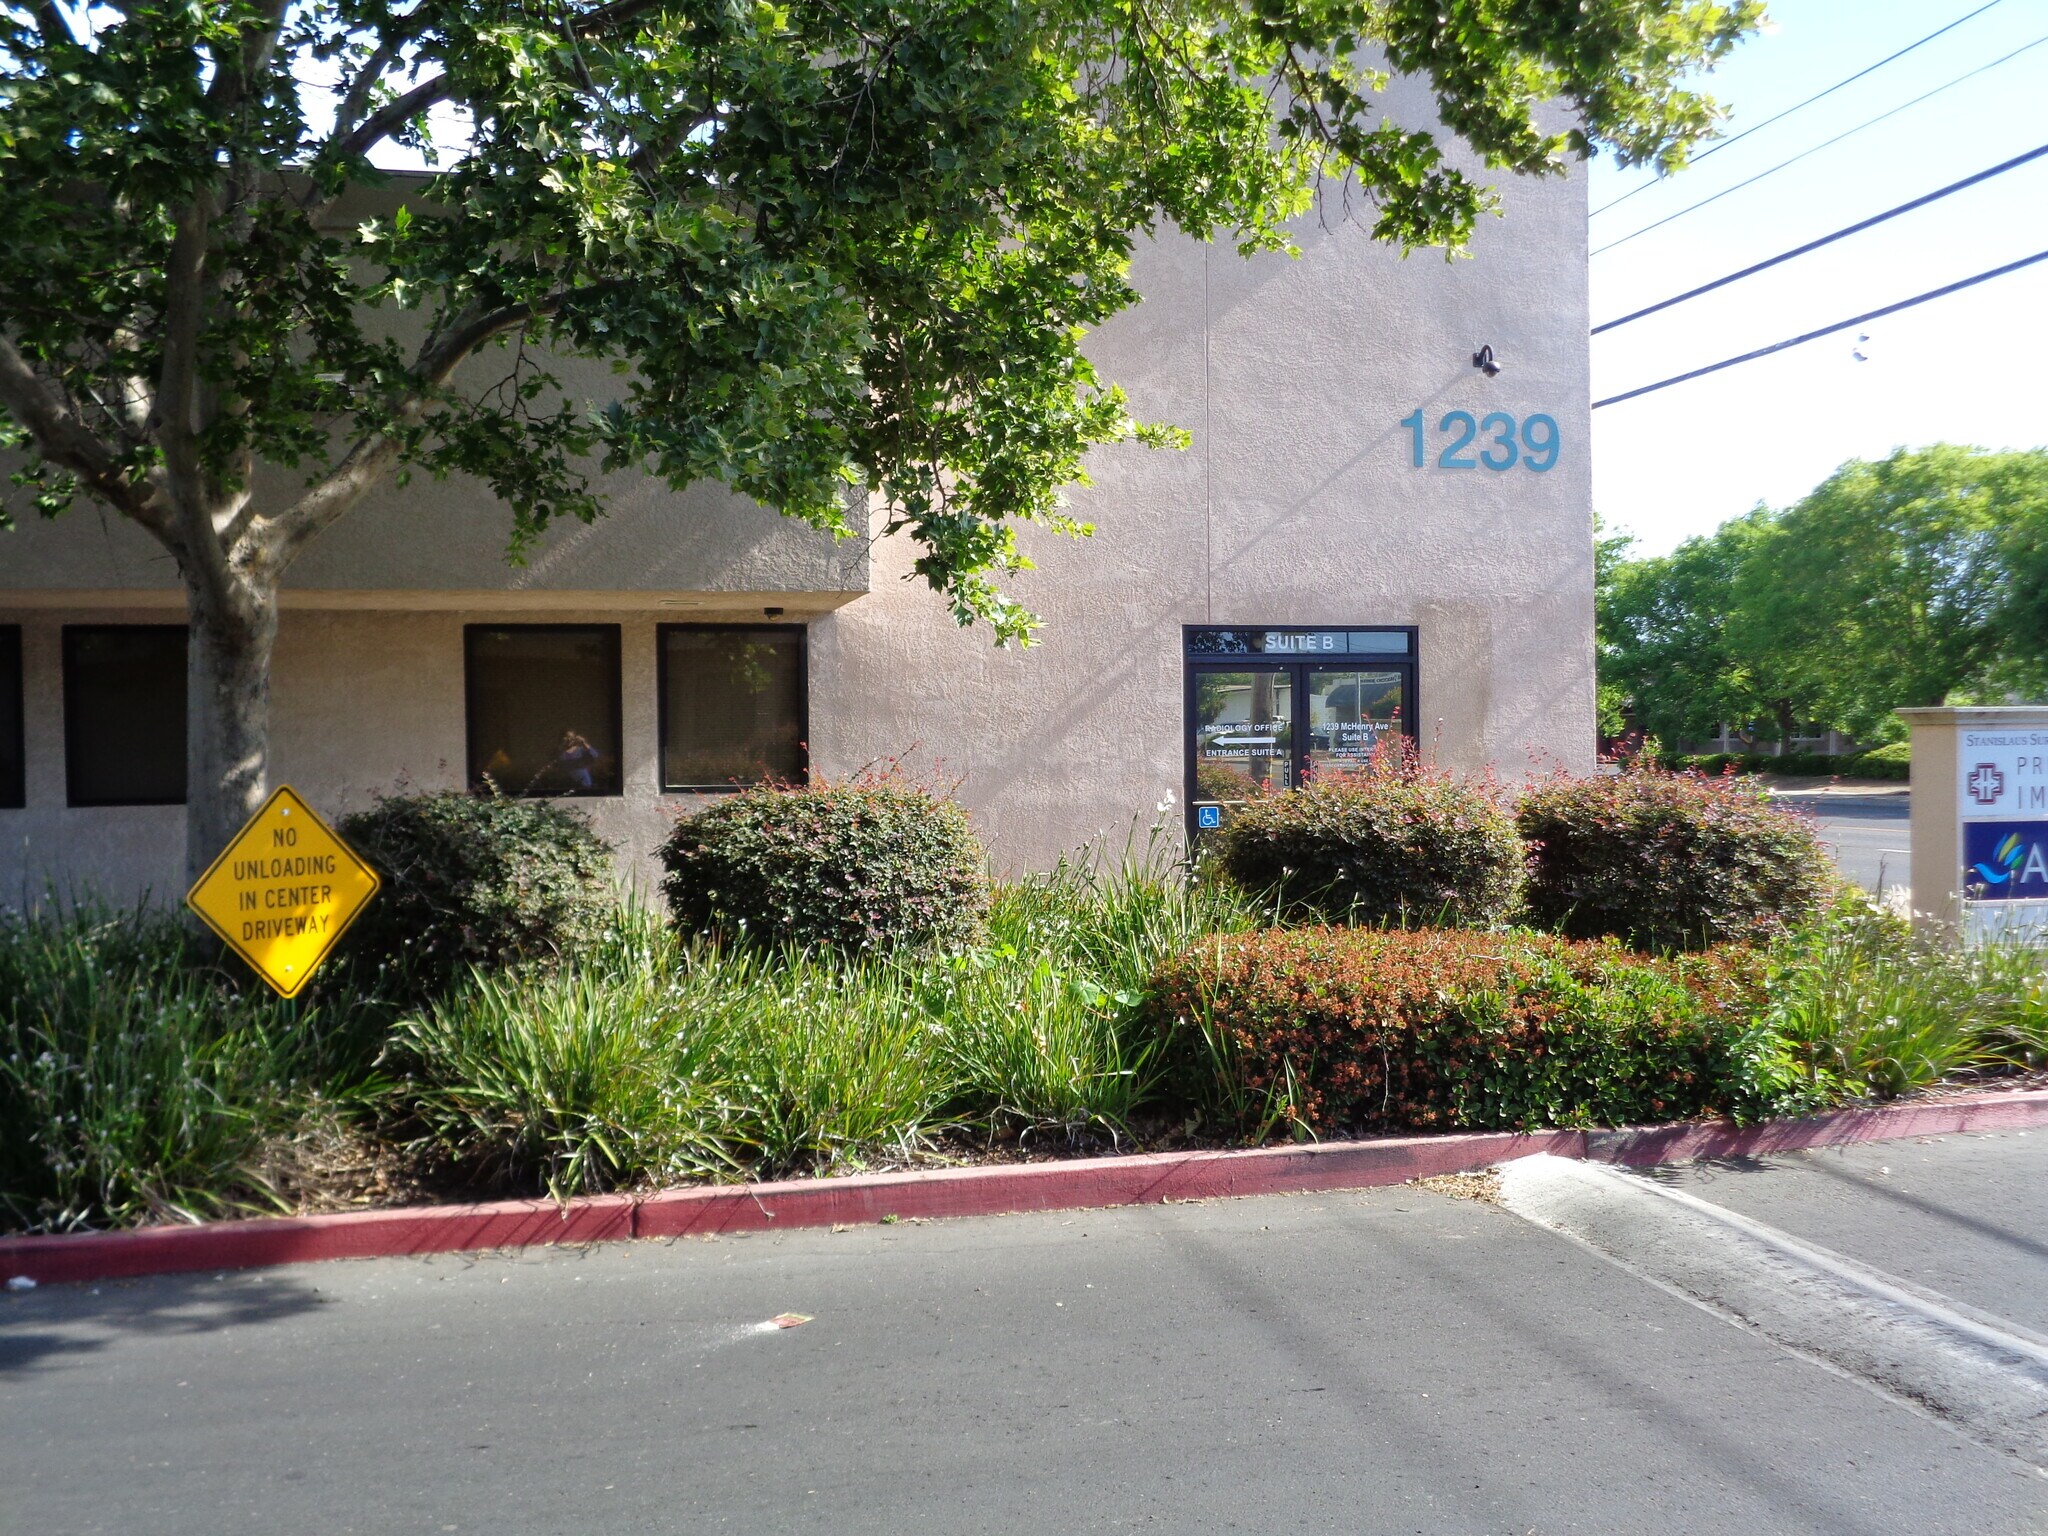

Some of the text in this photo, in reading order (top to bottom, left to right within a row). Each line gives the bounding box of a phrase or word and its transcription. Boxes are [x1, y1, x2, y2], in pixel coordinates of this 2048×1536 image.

[1401, 408, 1561, 472] 1239
[1265, 635, 1334, 650] SUITE B
[1204, 724, 1252, 732] RADIOLOGY
[1322, 722, 1389, 732] 1239 McHenry Ave
[1342, 732, 1369, 741] Suite B
[1967, 734, 2028, 747] STANISLAUS
[1206, 749, 1250, 757] ENTRANCE
[1251, 748, 1275, 756] SUITE
[273, 827, 297, 848] NO
[233, 854, 336, 881] UNLOADING
[239, 885, 332, 911] IN CENTER
[242, 914, 330, 942] DRIVEWAY
